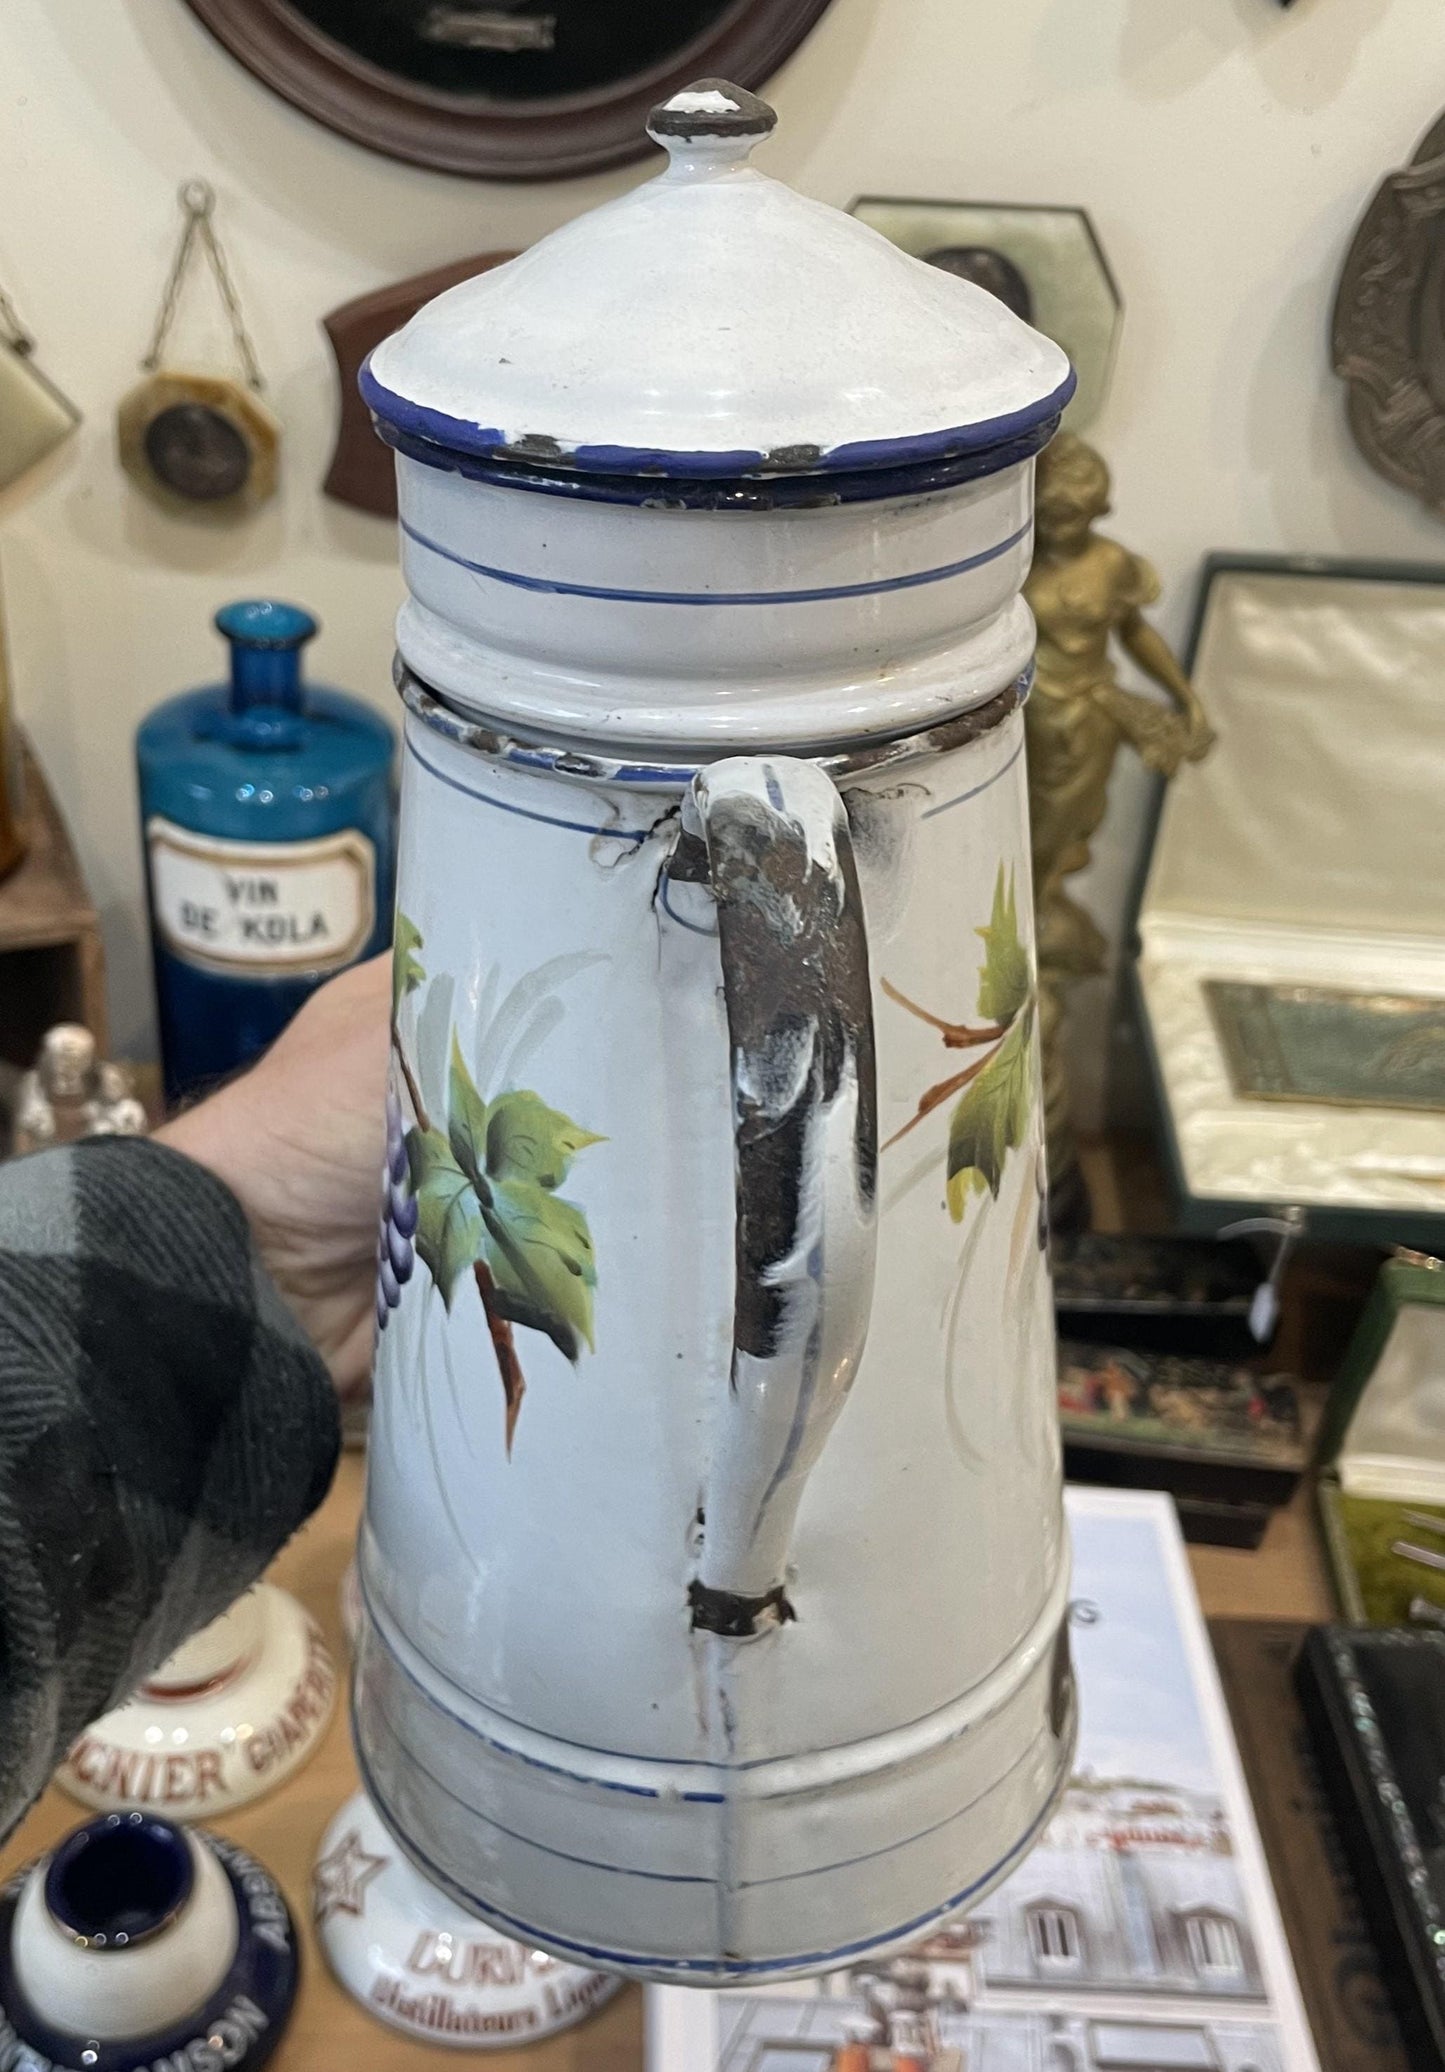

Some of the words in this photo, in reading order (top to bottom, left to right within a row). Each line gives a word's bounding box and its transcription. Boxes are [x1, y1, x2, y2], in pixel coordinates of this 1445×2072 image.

[224, 874, 279, 904] VIN
[180, 901, 218, 935] DE
[243, 912, 329, 944] KOLA
